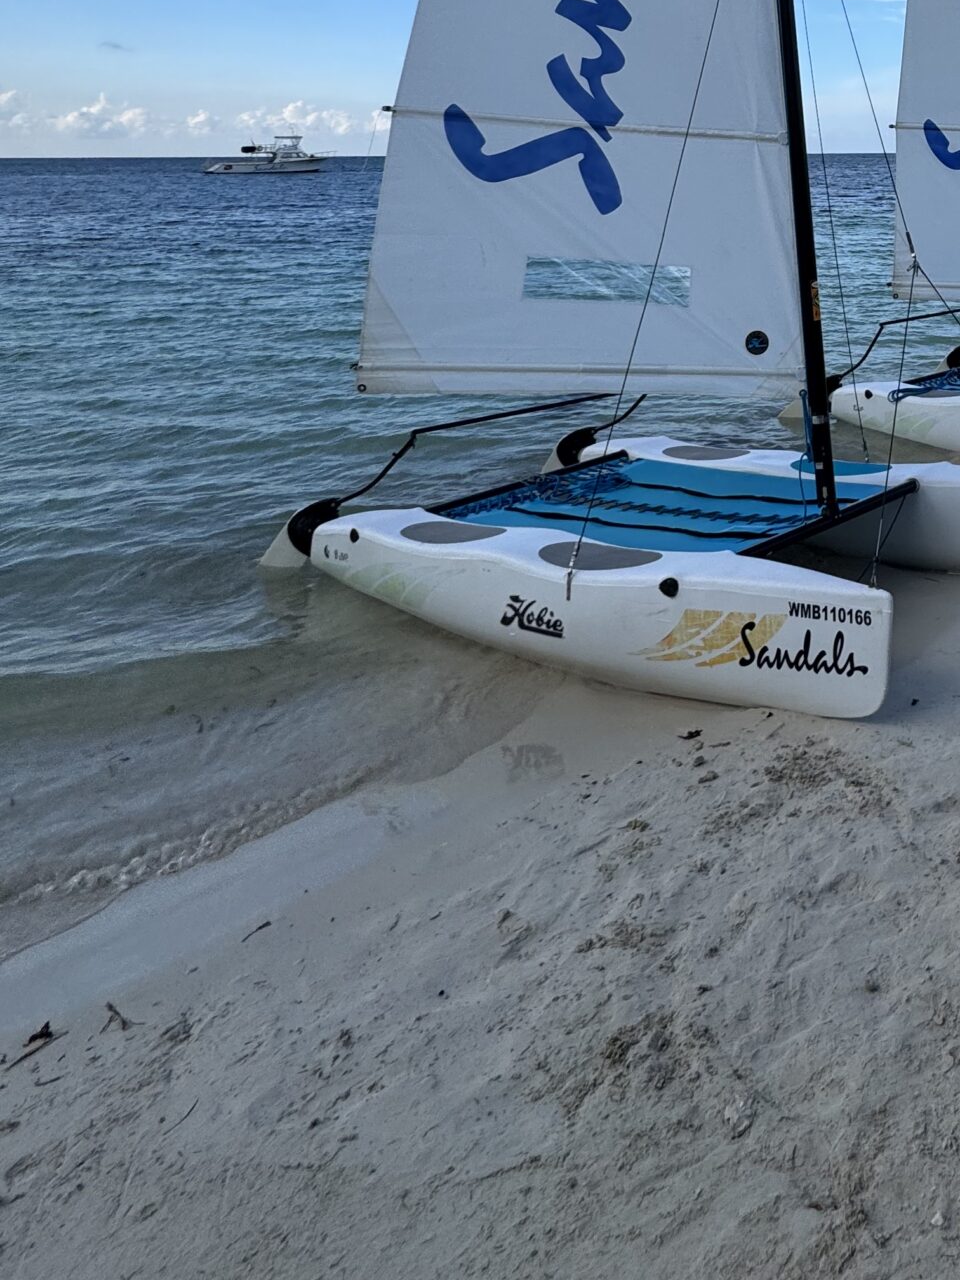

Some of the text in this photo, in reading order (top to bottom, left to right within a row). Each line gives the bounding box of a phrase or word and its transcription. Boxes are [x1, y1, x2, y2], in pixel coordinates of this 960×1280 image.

[500, 595, 564, 638] Hobie
[788, 601, 872, 626] WMB110166
[739, 621, 869, 677] Sandals
